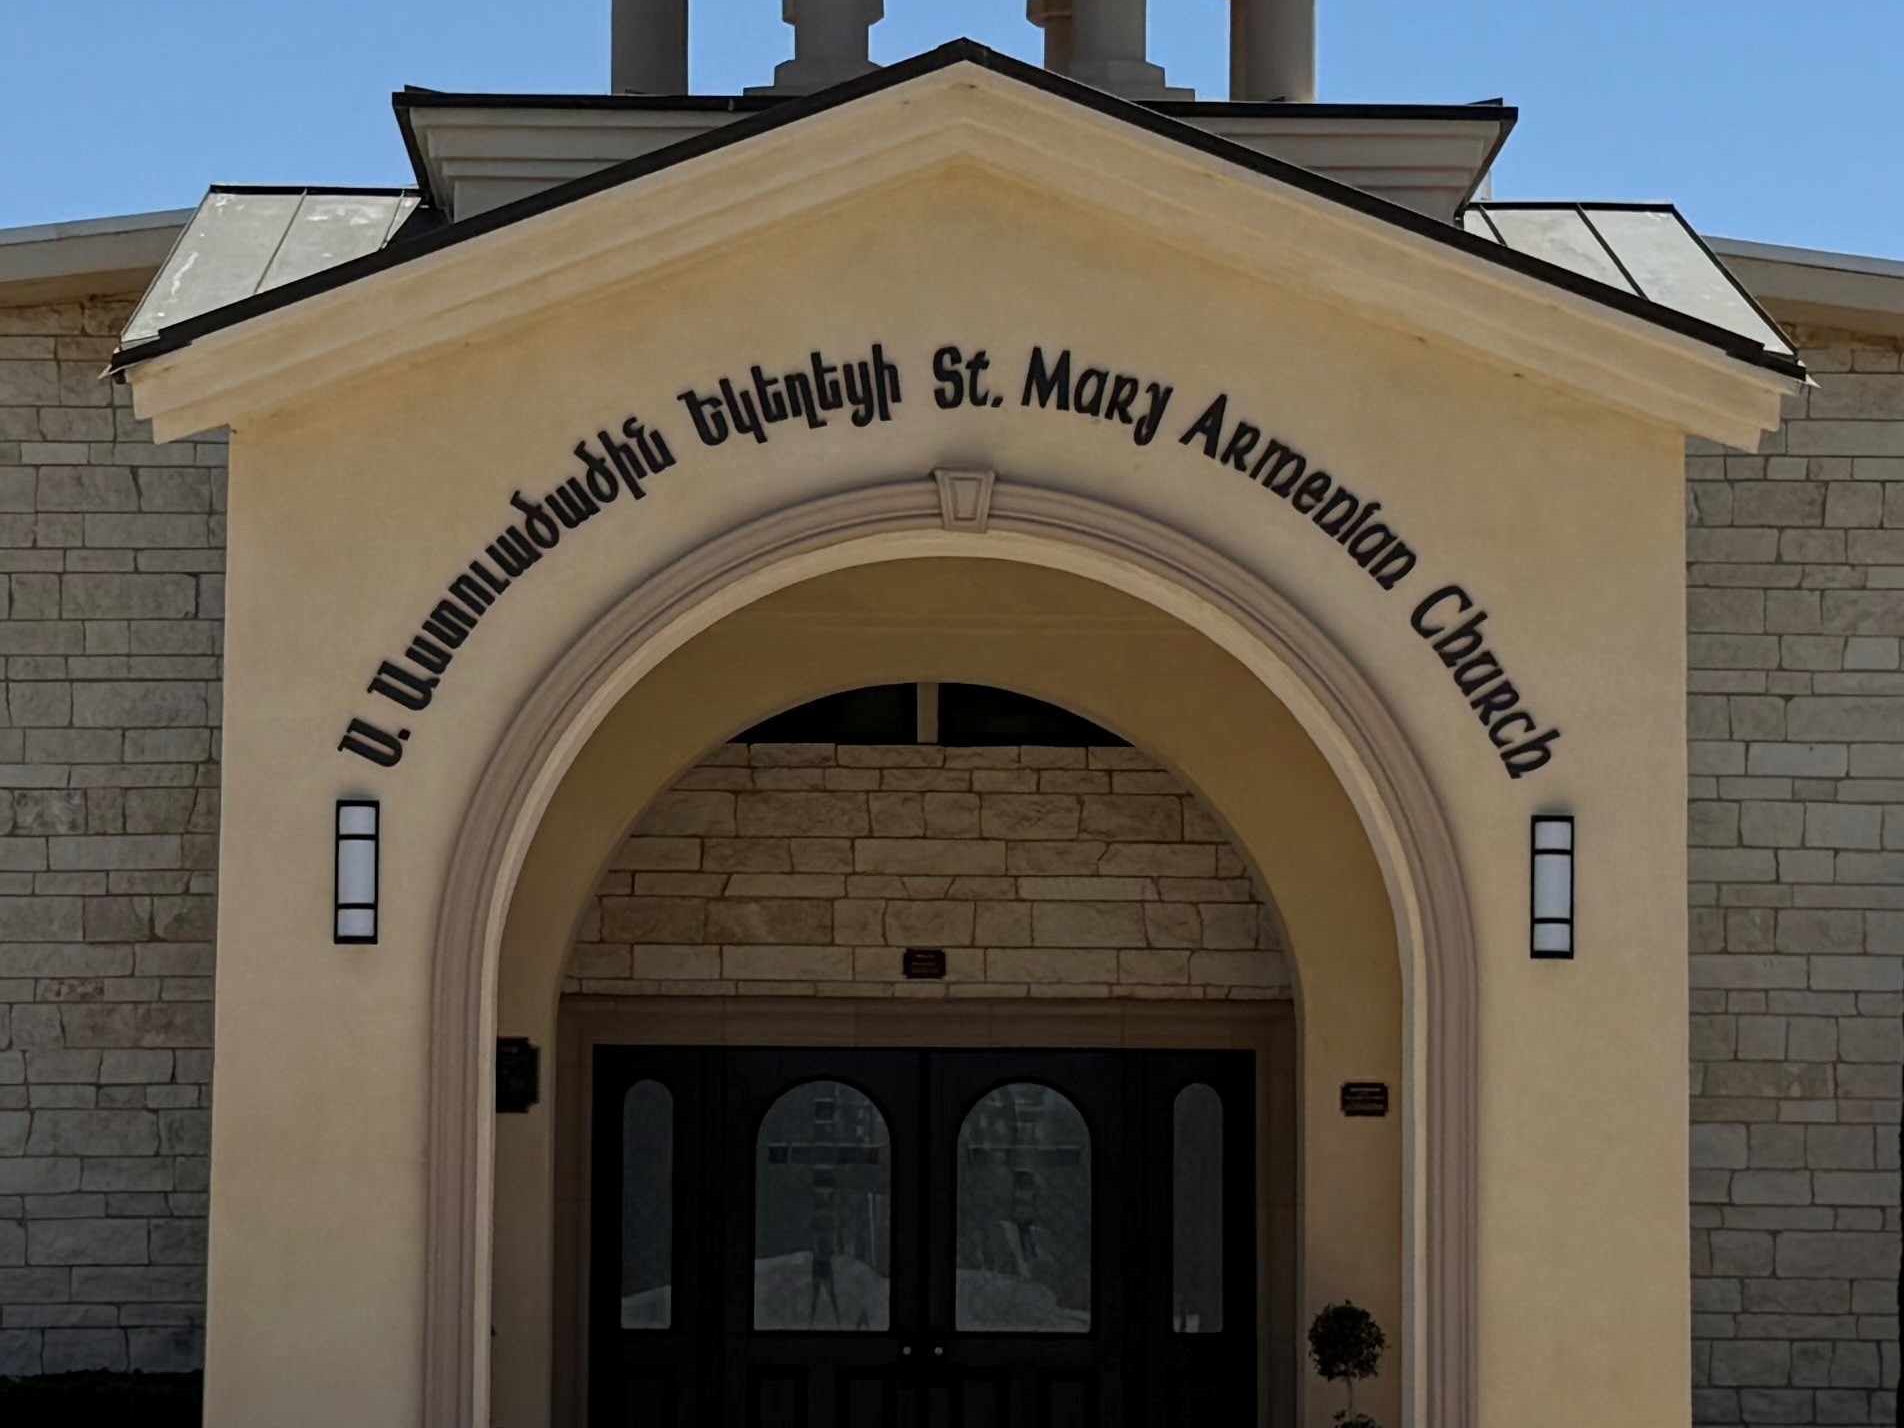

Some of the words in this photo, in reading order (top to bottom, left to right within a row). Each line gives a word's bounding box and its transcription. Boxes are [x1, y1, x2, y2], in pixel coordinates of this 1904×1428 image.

[932, 345, 1004, 410] St.
[1021, 345, 1174, 446] Mary
[1178, 392, 1417, 592] Armenian
[1409, 583, 1561, 780] Church
